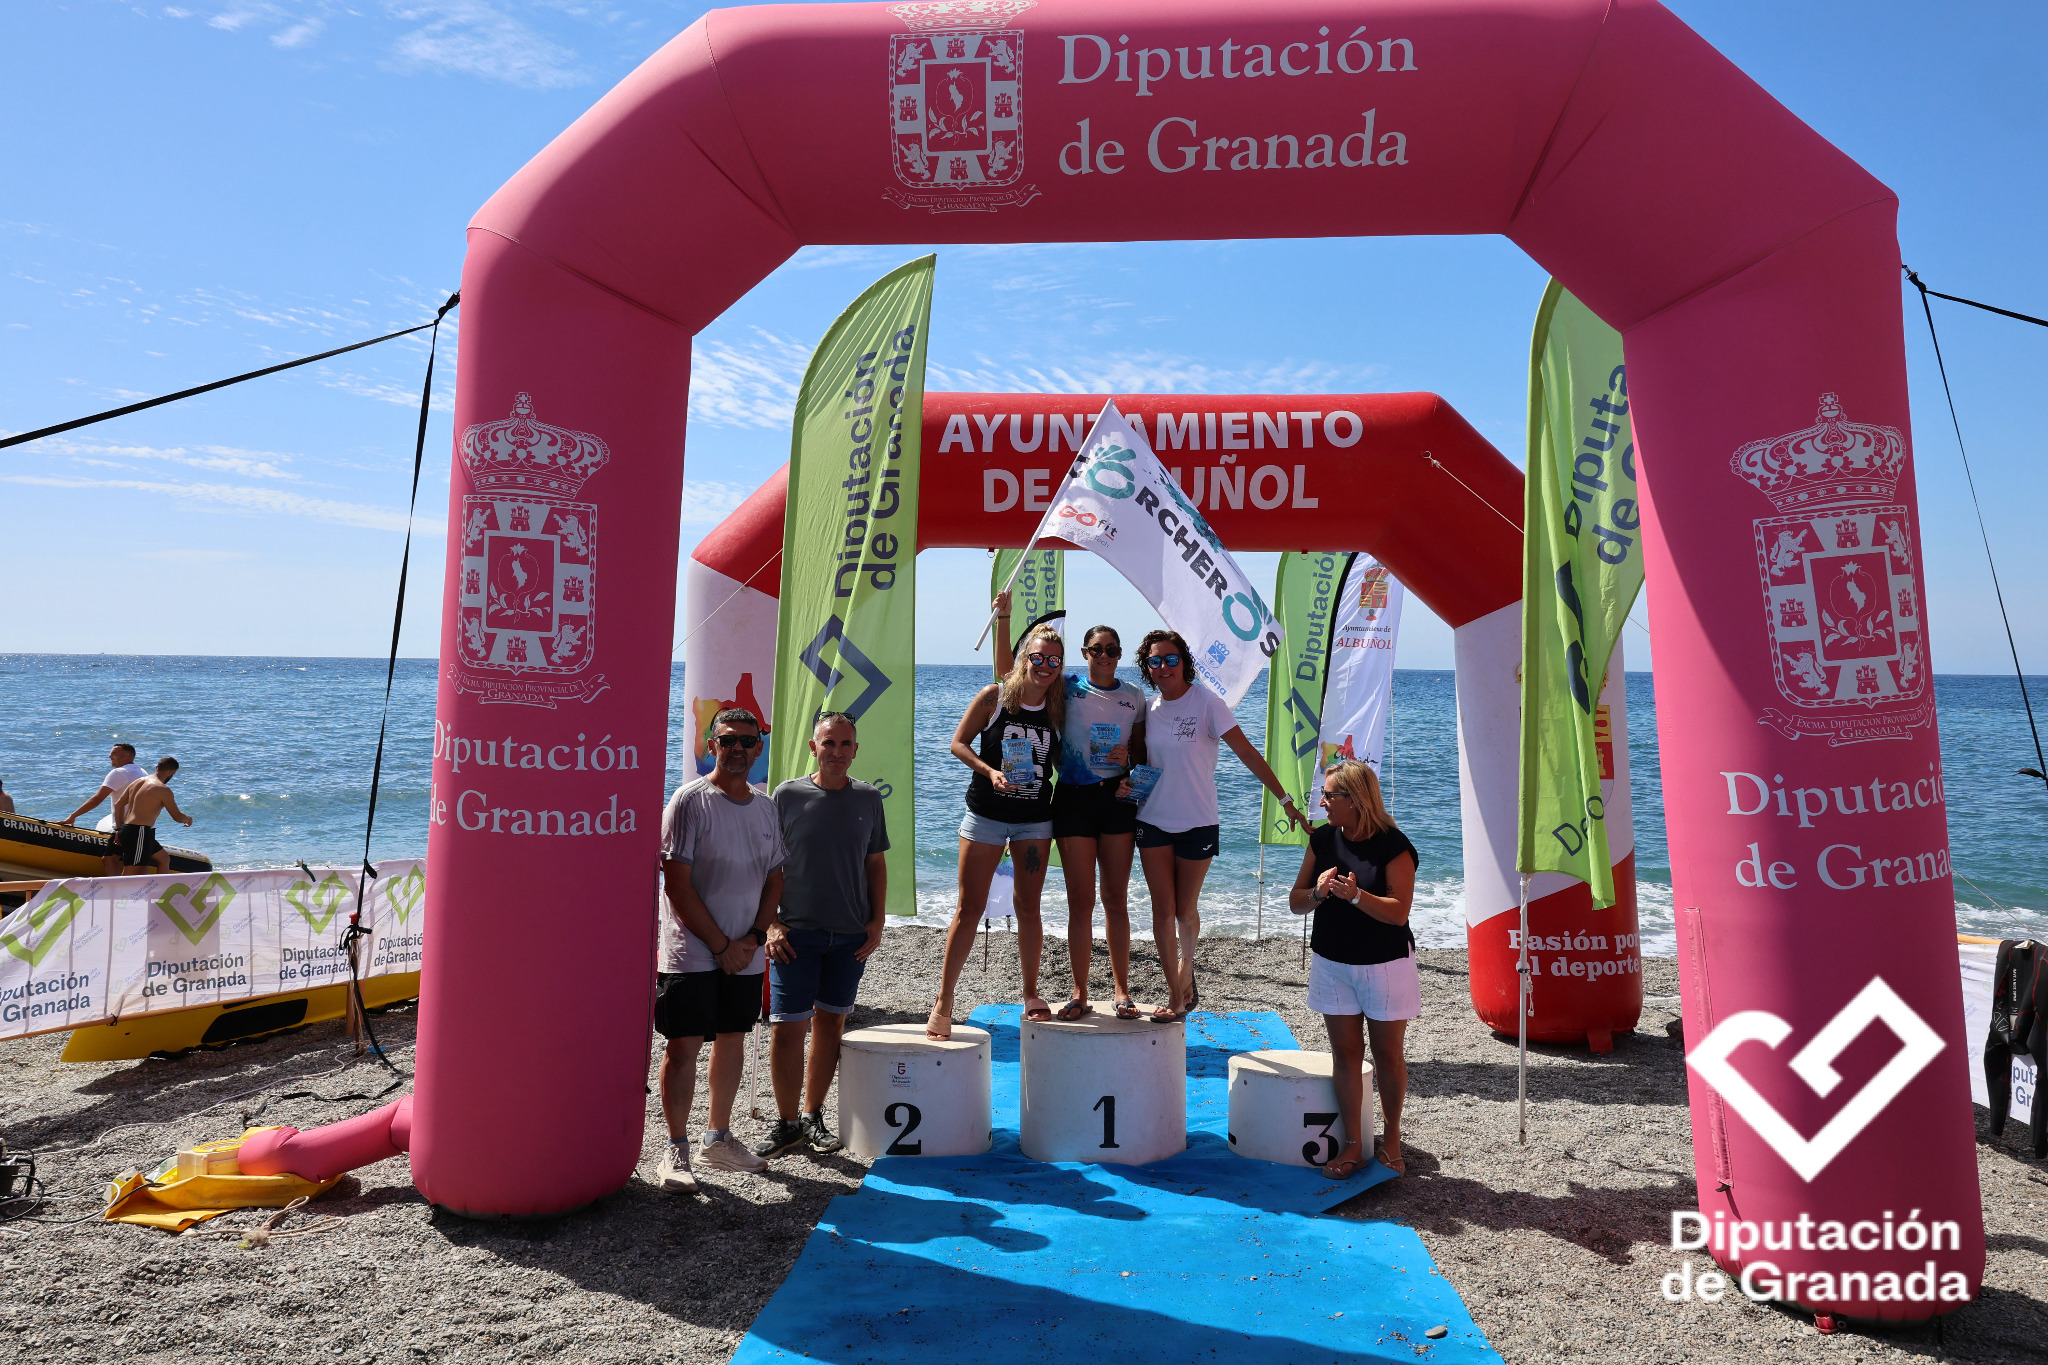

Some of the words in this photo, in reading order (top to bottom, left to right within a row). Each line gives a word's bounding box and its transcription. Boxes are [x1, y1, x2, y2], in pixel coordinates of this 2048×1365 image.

[1057, 25, 1418, 96] Diputación
[1058, 117, 1125, 175] de
[1147, 107, 1409, 173] Granada
[870, 324, 916, 520] Granada
[937, 410, 1364, 454] AYUNMIENTO
[834, 350, 878, 599] Diputación
[982, 468, 1051, 513] DE
[1168, 453, 1320, 511] UÑOL
[870, 531, 900, 592] de
[1040, 549, 1056, 615] nada
[1018, 559, 1038, 627] ación
[1295, 550, 1337, 682] Diputació
[1336, 636, 1394, 650] ALBUÑOL
[487, 689, 545, 702] GRANADA
[433, 719, 640, 774] Diputación
[1840, 725, 1903, 738] GRANADA
[456, 789, 637, 836] Granada
[1719, 762, 1945, 829] Diputació
[3, 818, 109, 847] GRANADA-DEPORTES
[1735, 842, 1798, 890] de
[1816, 843, 1952, 890] Grana
[147, 953, 244, 978] Diputación
[374, 953, 385, 967] de
[378, 932, 423, 952] Diputació
[0, 971, 90, 1006] iputación
[142, 980, 168, 998] de
[173, 971, 247, 993] Granada
[280, 965, 297, 980] de
[1550, 954, 1640, 982] deporte
[3, 992, 91, 1022] Granada
[884, 1102, 923, 1156] 2
[1092, 1095, 1121, 1148] 1
[1302, 1112, 1339, 1166] 3
